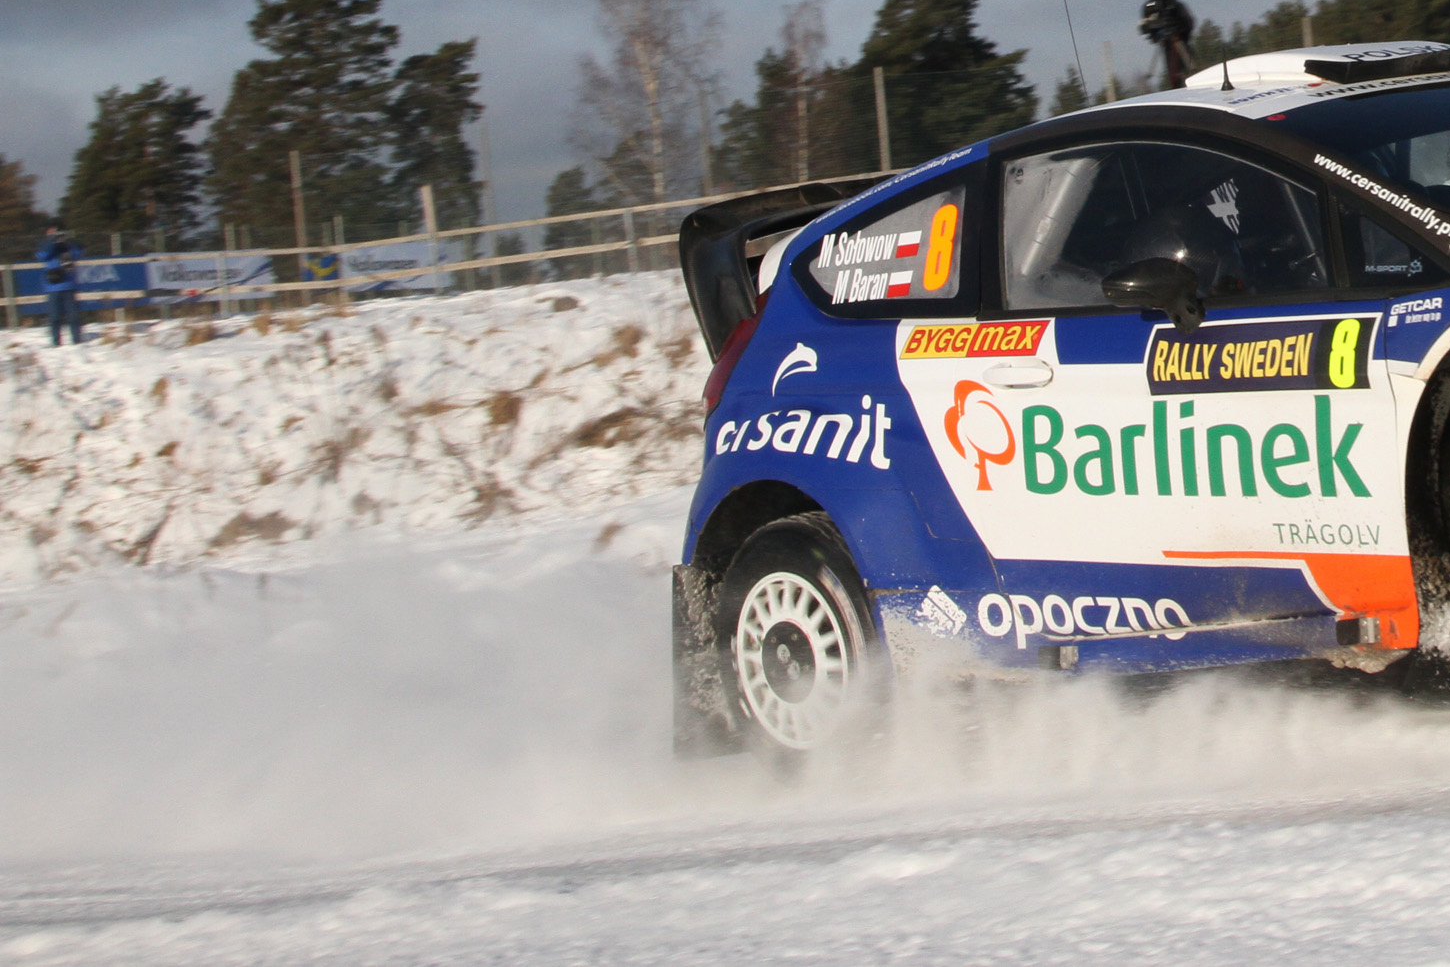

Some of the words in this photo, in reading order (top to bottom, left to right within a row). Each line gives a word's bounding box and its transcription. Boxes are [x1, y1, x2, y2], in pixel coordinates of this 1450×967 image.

[818, 234, 835, 268] M
[923, 203, 958, 291] 8
[832, 269, 850, 305] M
[849, 268, 889, 303] Baran
[1390, 297, 1443, 315] GETCAR
[1152, 340, 1218, 382] RALLY
[1219, 332, 1314, 379] SWEDEN
[1329, 318, 1360, 388] 8
[1022, 395, 1373, 498] Barlinek
[1273, 518, 1380, 546] TRÄGOLV
[978, 593, 1193, 650] opoczno
